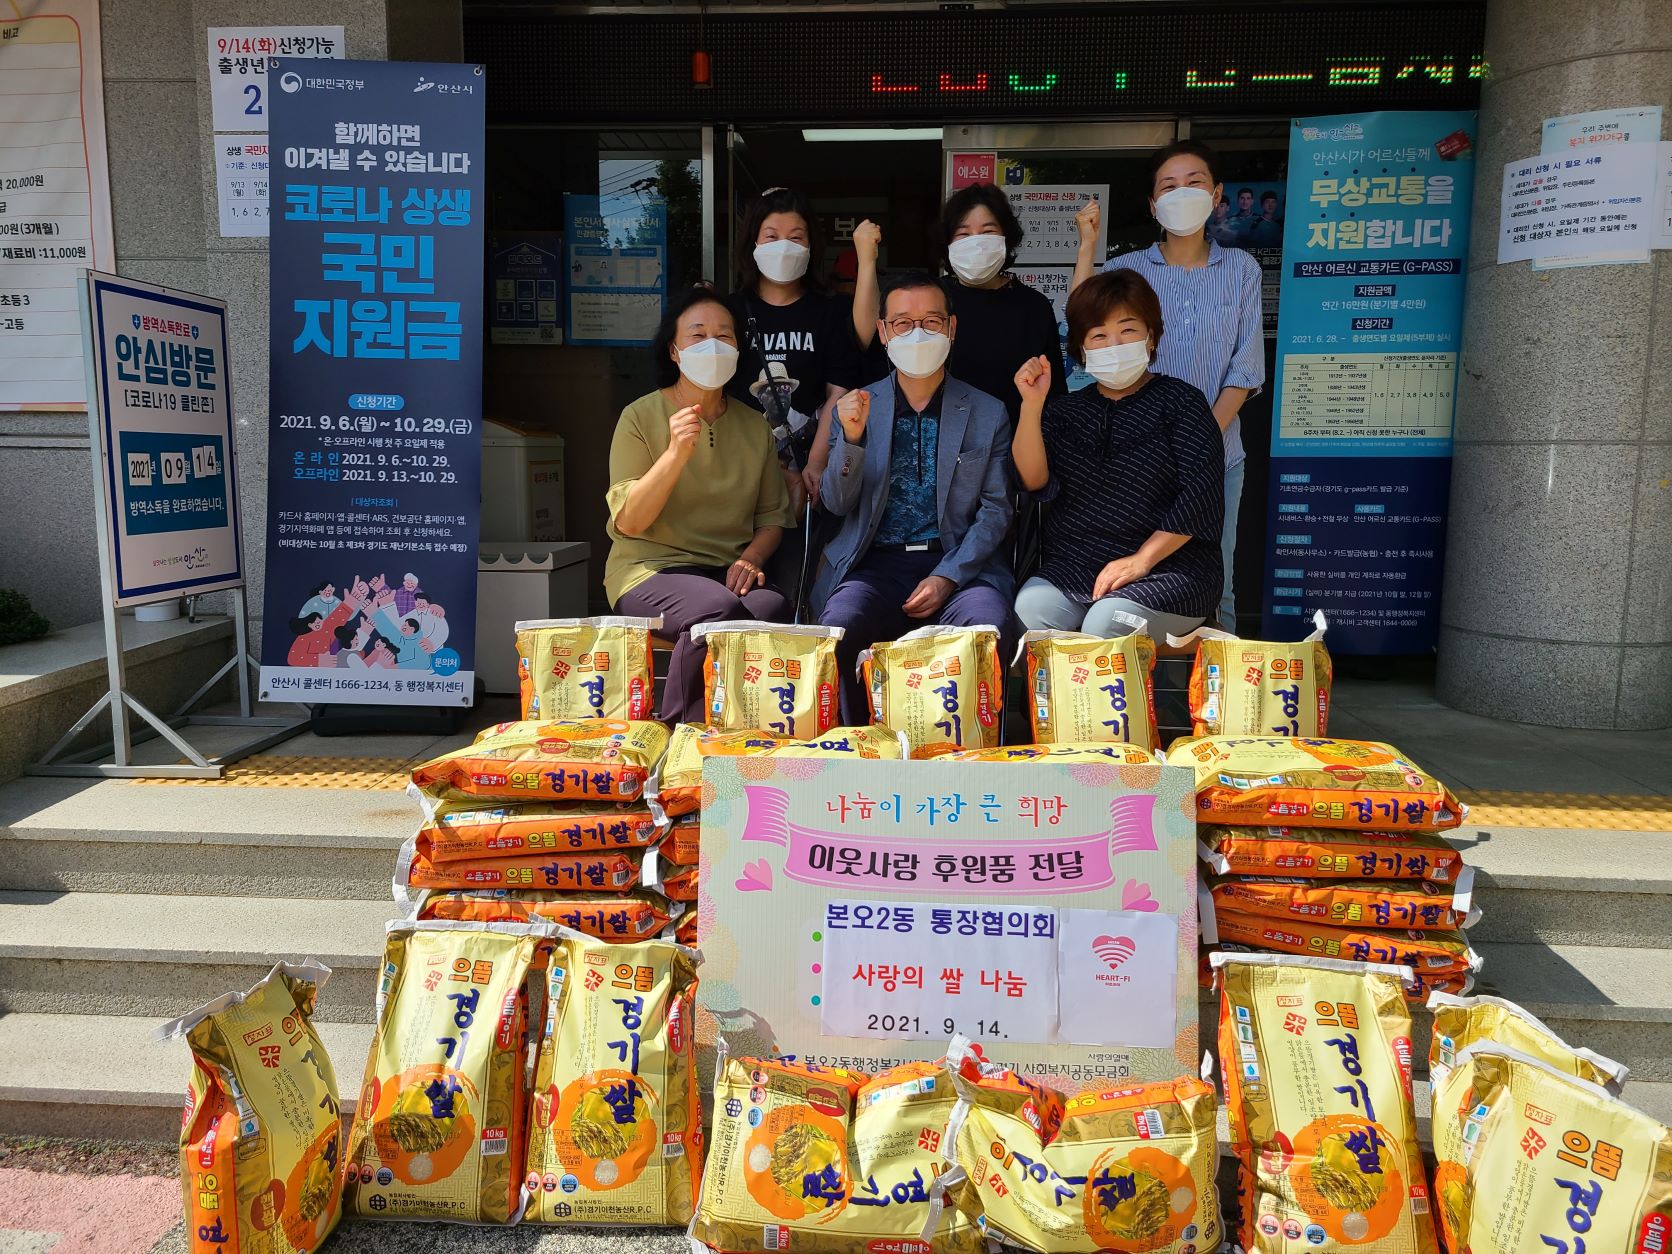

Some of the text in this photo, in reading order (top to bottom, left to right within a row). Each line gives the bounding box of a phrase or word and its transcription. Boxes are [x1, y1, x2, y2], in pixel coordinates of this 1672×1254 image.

[3, 27, 19, 40] 비고
[218, 57, 268, 74] 출생년
[306, 78, 365, 90] 대한민국정부
[438, 84, 473, 94] 안산시
[244, 85, 262, 114] 2
[335, 122, 421, 146] 함께하면
[227, 146, 241, 155] 상생
[284, 147, 471, 174] 이겨낼 수 있습니다
[1313, 147, 1430, 165] 안산시가 어르신들께
[958, 166, 989, 179] 에스원
[1519, 168, 1532, 176] 대리
[1535, 164, 1549, 174] 신청
[1565, 160, 1580, 169] 필요
[1586, 157, 1601, 165] 서류
[6, 175, 44, 189] 20,000원
[1310, 175, 1454, 208] 무상교통을
[284, 184, 471, 226] 코로나 상생
[1306, 219, 1452, 250] 지원합니다
[322, 232, 434, 295] 국민
[1302, 261, 1452, 276] 안산 어르신 교통카드 (G-PASS)
[1042, 285, 1067, 293] 끝자리
[1358, 286, 1392, 296] 지원금액
[293, 299, 462, 360] 지원금
[1355, 319, 1390, 328] 신청기간
[1292, 336, 1312, 344] 2021.
[115, 334, 216, 391] 안심방문
[357, 397, 396, 408] 신청기간
[280, 416, 316, 429] 2021.
[367, 438, 383, 447] 시행
[385, 438, 393, 447] 첫
[395, 439, 402, 447] 주
[404, 439, 427, 448] 요일제
[429, 439, 445, 449] 적용
[342, 454, 374, 465] 2021.
[293, 468, 339, 481] 오프라인
[342, 470, 375, 481] 2021.
[130, 497, 224, 516] 방역소독을 완료하였습니다.
[278, 512, 302, 521] 카드사
[435, 657, 457, 667] 문의처
[578, 651, 610, 673] 으뜸
[768, 656, 802, 679] 으뜸
[929, 655, 961, 680] 으뜸
[1095, 653, 1126, 676] 으뜸
[1270, 658, 1304, 680] 으뜸
[271, 678, 464, 693] 안산시 콜센터 1666-1234, 동 행정복지센터
[511, 772, 542, 790] 으뜸
[544, 768, 614, 795] 경기쌀
[826, 791, 1069, 827] 나눔이 가장 큰 희망
[1312, 801, 1345, 820] 으뜸
[1351, 797, 1429, 824] 경기쌀
[528, 821, 631, 848] 으뜸 경기쌀
[506, 862, 608, 886] 으뜸 경기쌀
[808, 843, 1085, 884] 이웃사랑 후원품 전달
[1318, 852, 1430, 876] 으뜸 경기쌀
[827, 903, 1055, 940] 본오2동 통장협의회
[1332, 900, 1444, 926] 으뜸 경기쌀
[448, 957, 494, 985] 으뜸
[612, 964, 654, 992] 으뜸
[852, 963, 1028, 998] 사랑의 쌀 나눔
[1096, 974, 1130, 982] HEART-FI
[868, 1014, 930, 1035] 2021.
[977, 1020, 1009, 1039] 14.
[1315, 1000, 1359, 1030] 으뜸
[424, 988, 481, 1119] 경기쌀
[604, 996, 645, 1124] 경기쌀
[1088, 1053, 1130, 1062] 사랑의열매
[1023, 1062, 1130, 1081] 사회복지공동모금회
[1323, 1033, 1385, 1175] 경기쌀
[1556, 1129, 1624, 1181] 으뜸
